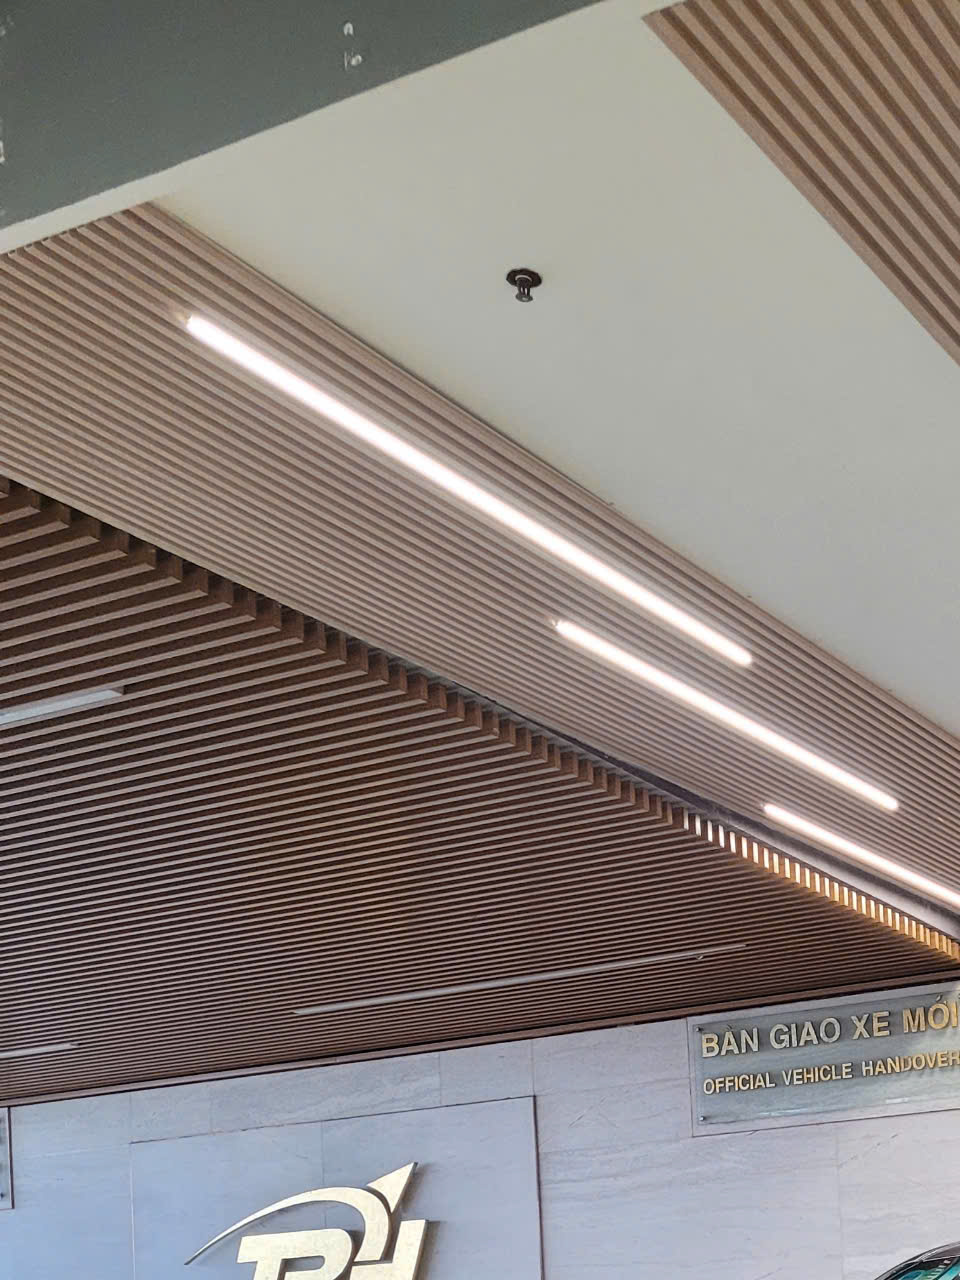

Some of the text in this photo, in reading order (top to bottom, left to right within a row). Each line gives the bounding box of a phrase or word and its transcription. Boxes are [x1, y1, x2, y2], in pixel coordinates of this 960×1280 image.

[769, 1016, 841, 1049] GIAO
[851, 1010, 891, 1040] XE
[902, 994, 959, 1033] MỚI
[703, 1067, 776, 1095] OFFICIAL
[782, 1062, 853, 1086] VEHICLE
